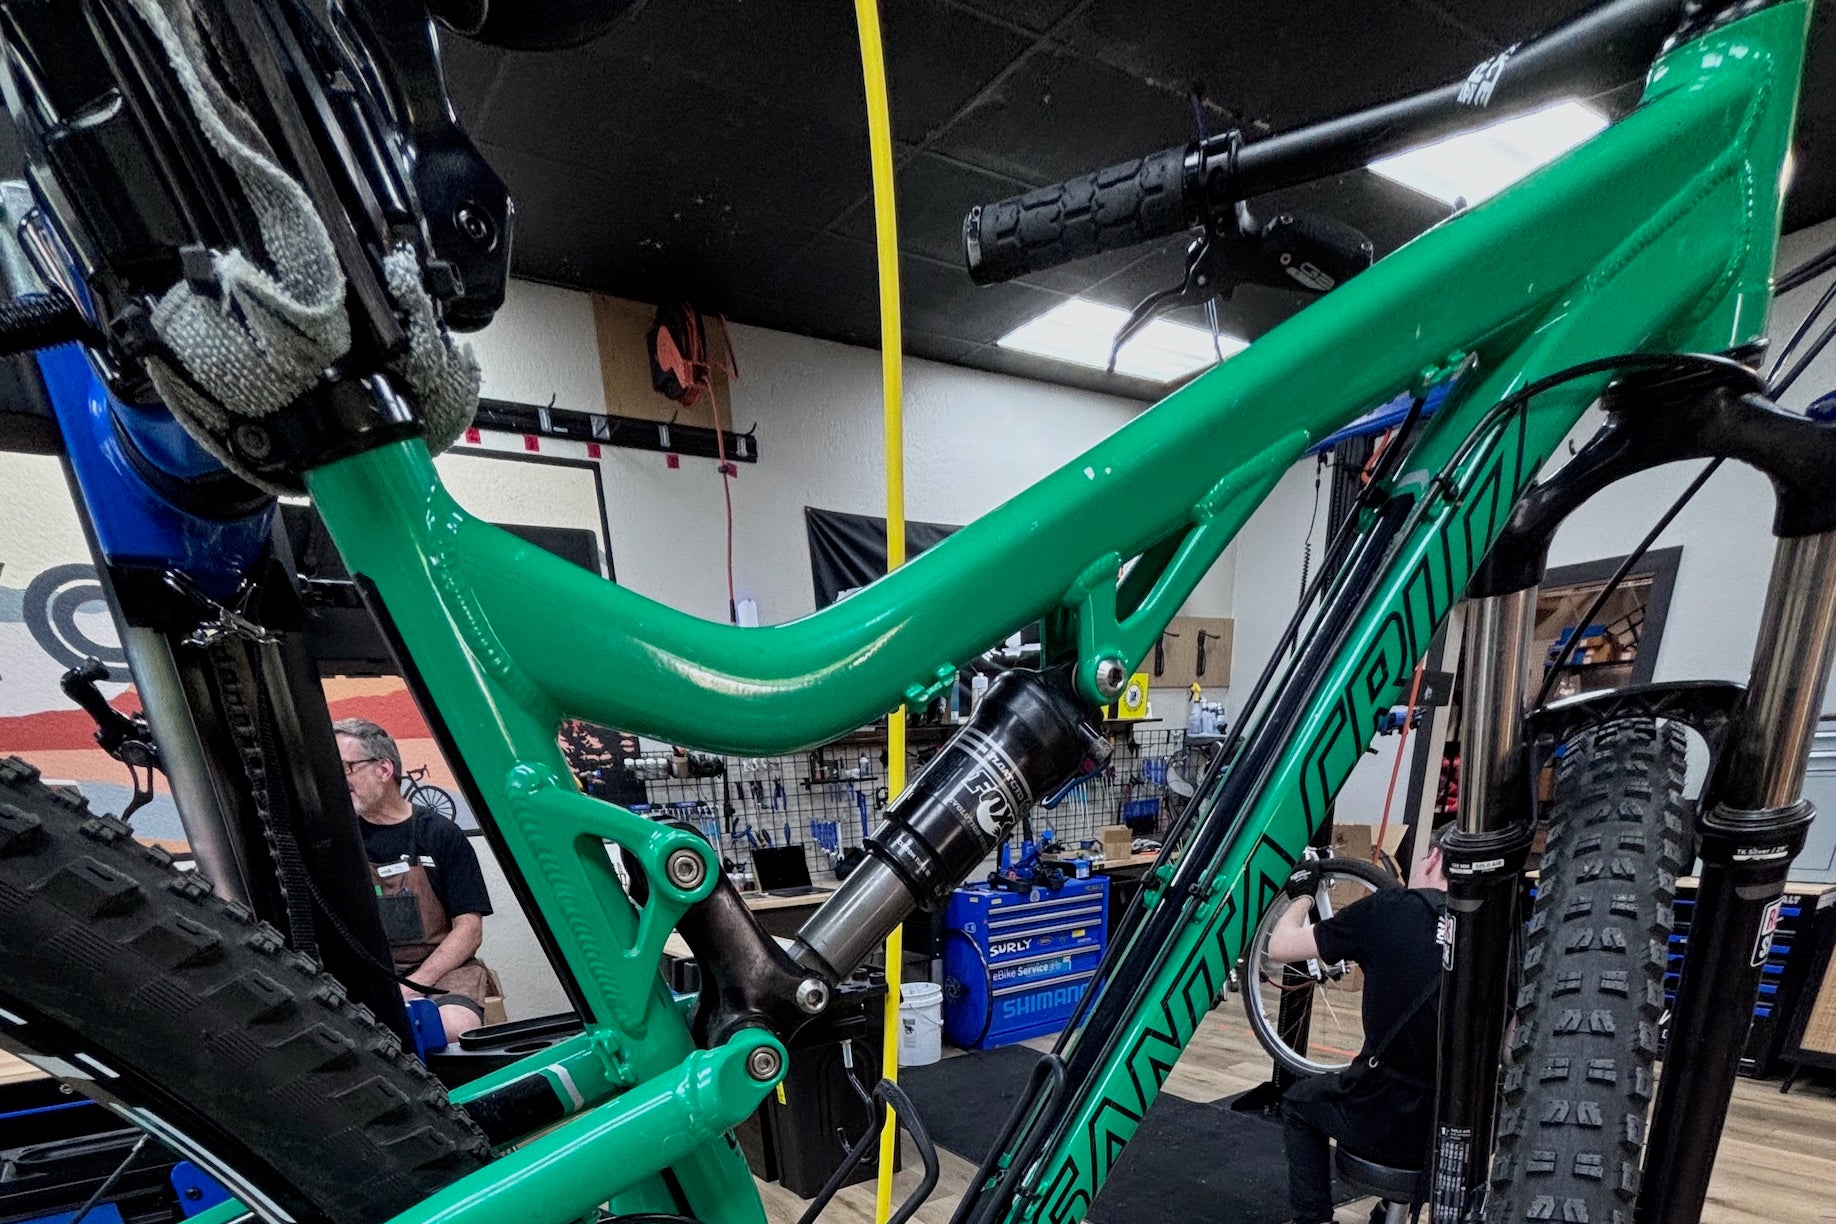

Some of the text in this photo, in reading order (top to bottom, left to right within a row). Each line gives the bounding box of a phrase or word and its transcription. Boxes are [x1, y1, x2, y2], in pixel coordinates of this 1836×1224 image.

[1300, 378, 1543, 842] CRUZ
[961, 769, 1017, 832] FOX
[989, 938, 1032, 957] SURLY
[992, 963, 1049, 981] eBike Service
